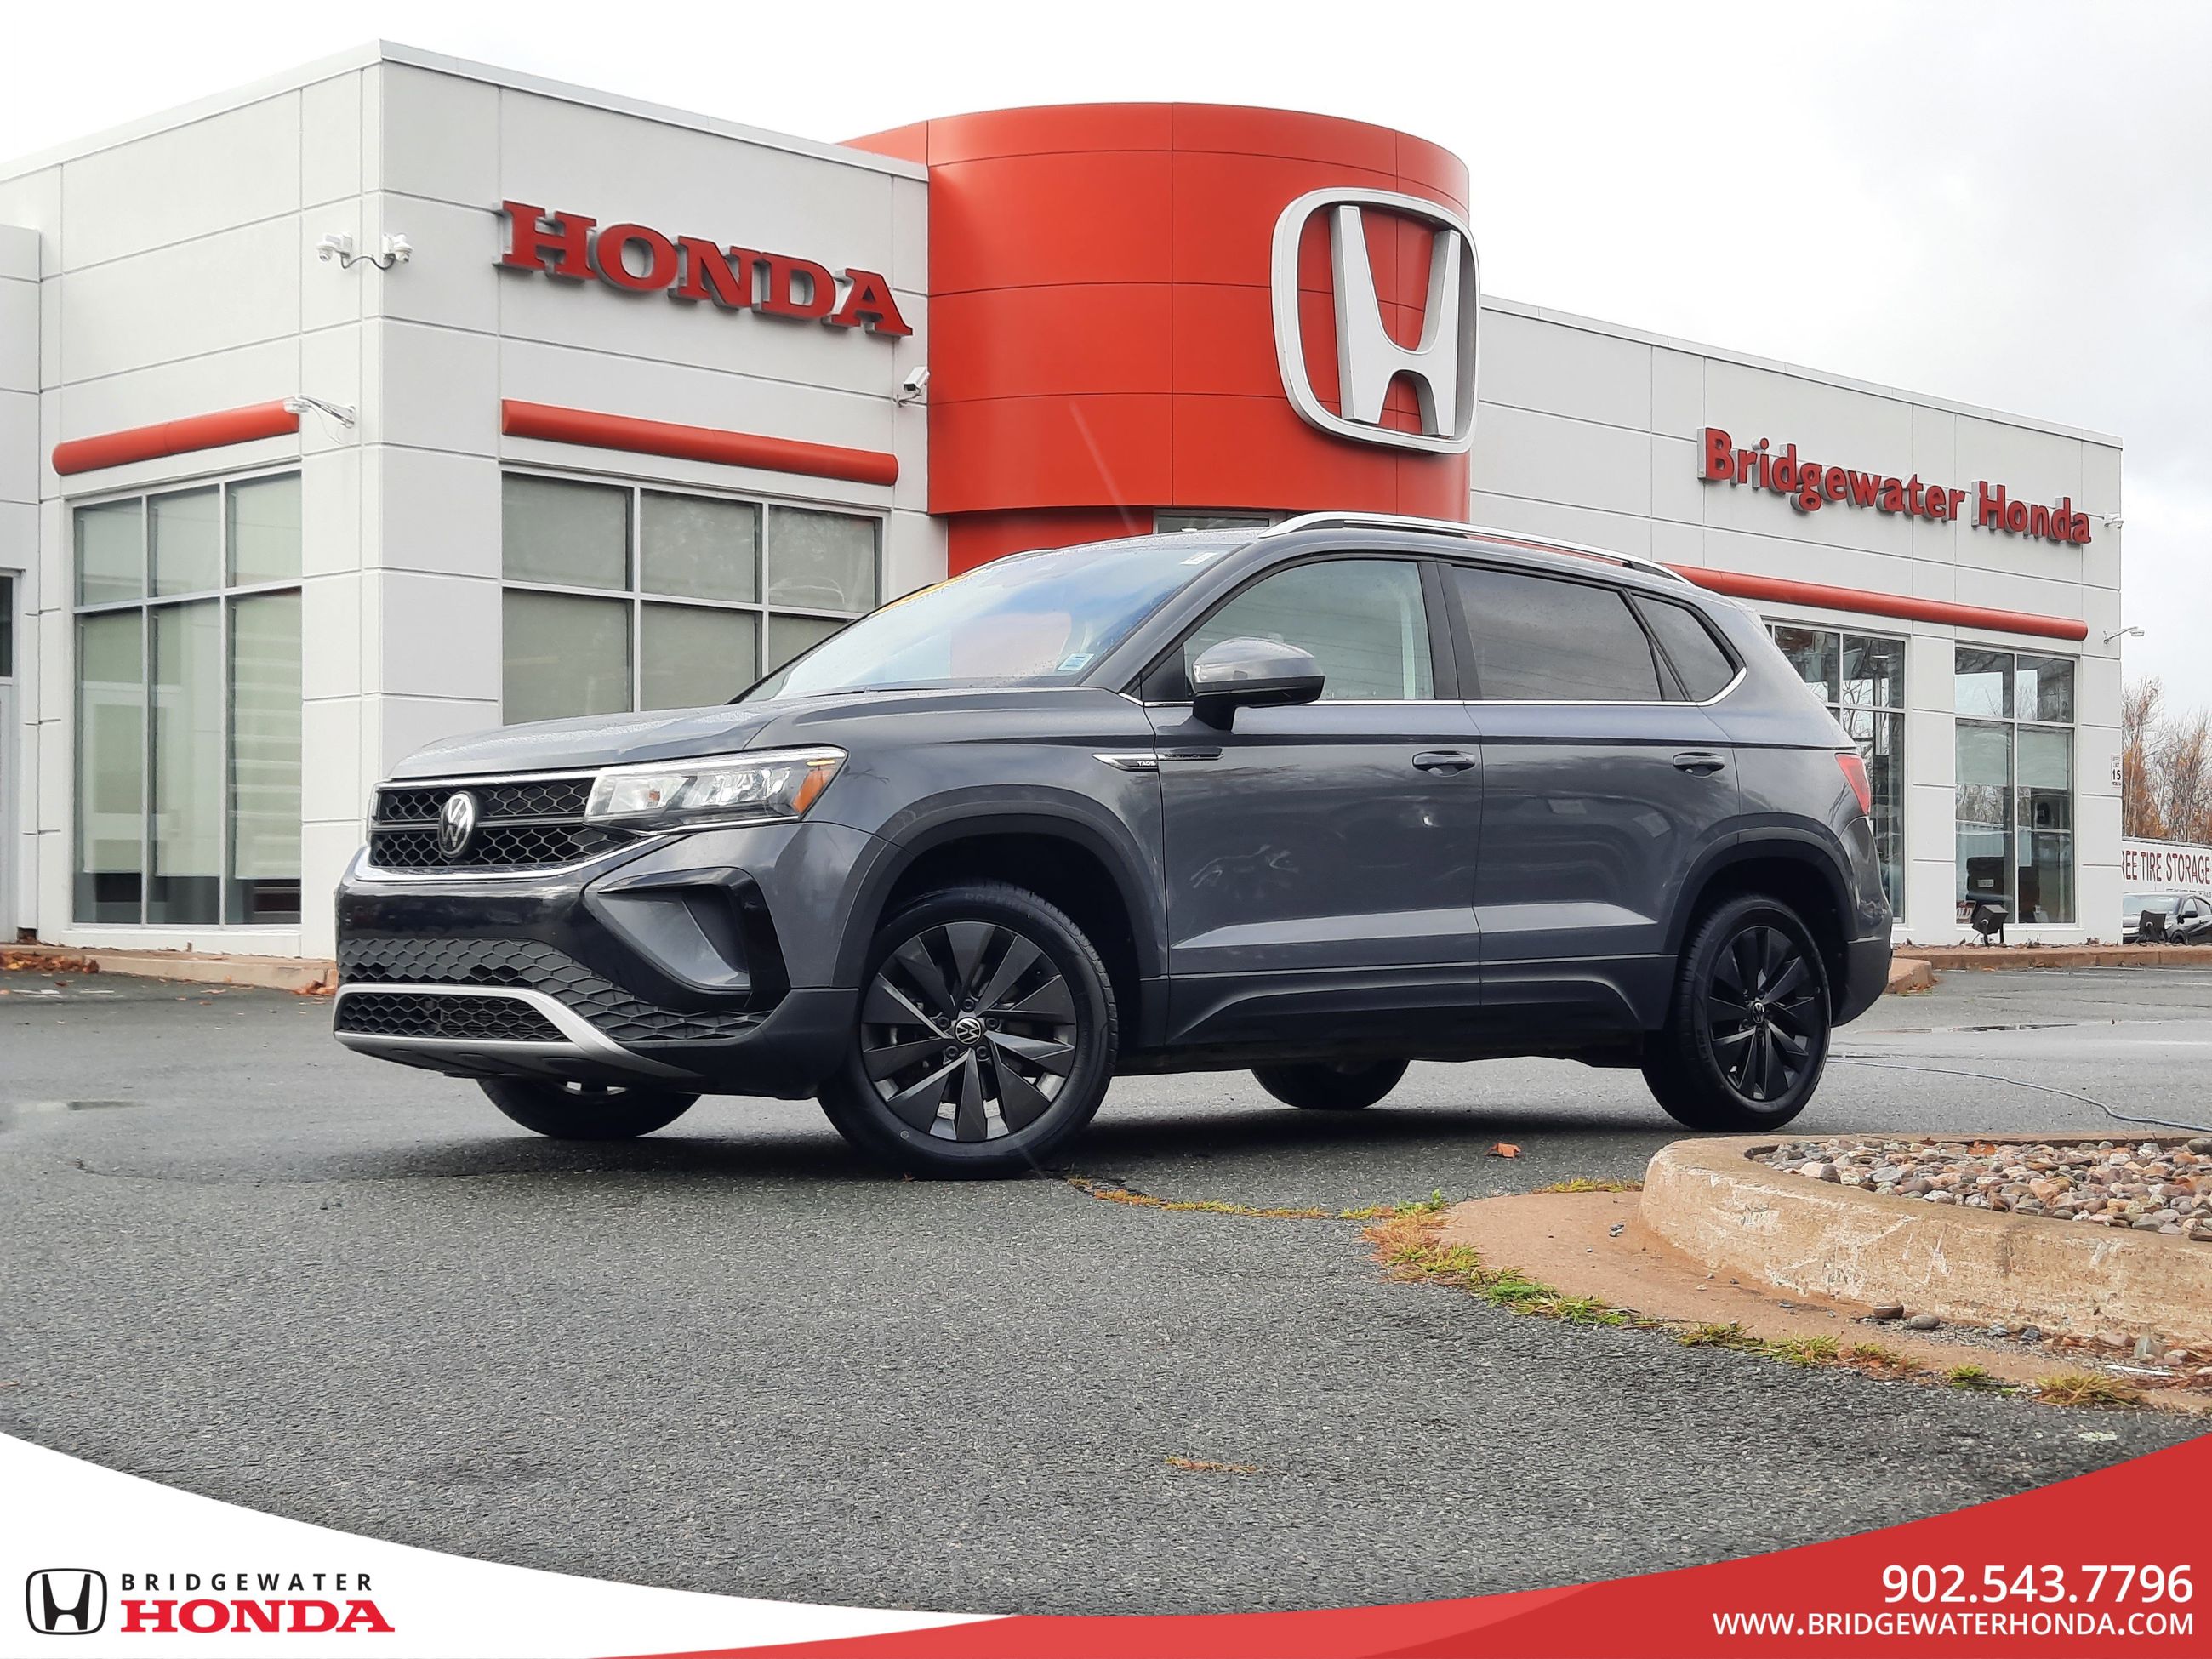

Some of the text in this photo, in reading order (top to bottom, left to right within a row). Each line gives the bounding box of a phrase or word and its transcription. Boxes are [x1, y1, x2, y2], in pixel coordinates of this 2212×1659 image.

[502, 200, 913, 336] HONDA
[1703, 427, 2092, 544] Bridgewater Honda
[2122, 850, 2210, 885] REE TIRE STORAGE
[1957, 907, 1973, 919] OLD
